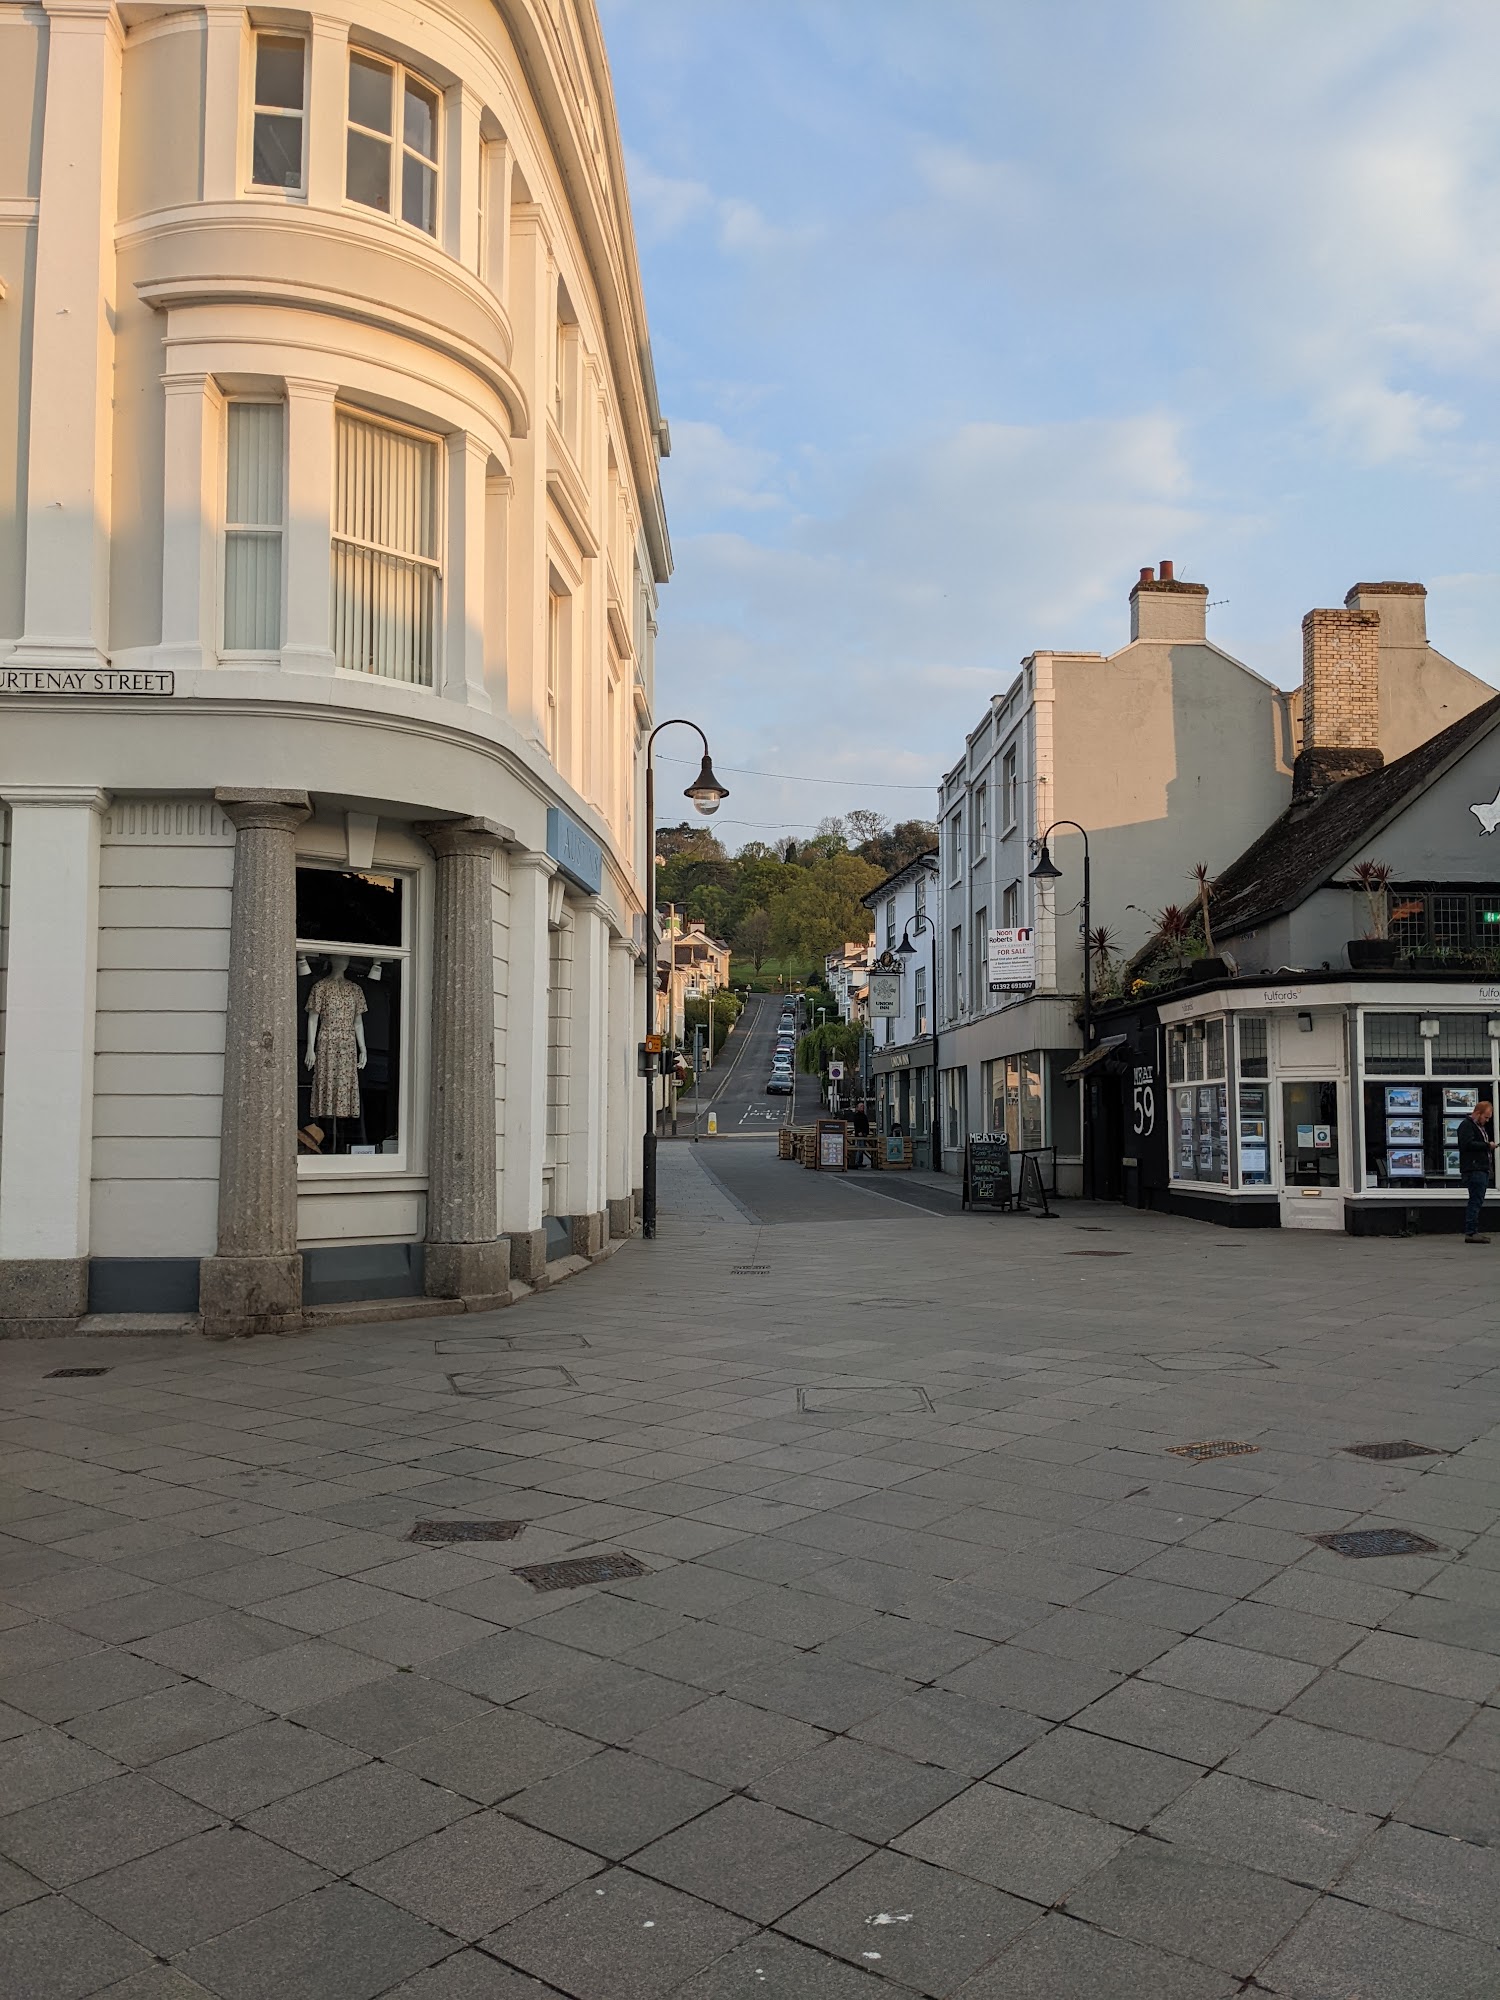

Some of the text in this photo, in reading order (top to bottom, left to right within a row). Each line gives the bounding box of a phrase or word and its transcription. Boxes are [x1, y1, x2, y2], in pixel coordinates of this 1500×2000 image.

[94, 673, 169, 691] STREET
[1264, 990, 1298, 1000] fulfords
[1133, 1066, 1153, 1085] MEAT
[1133, 1086, 1154, 1136] 59
[969, 1133, 1007, 1145] MEAT59
